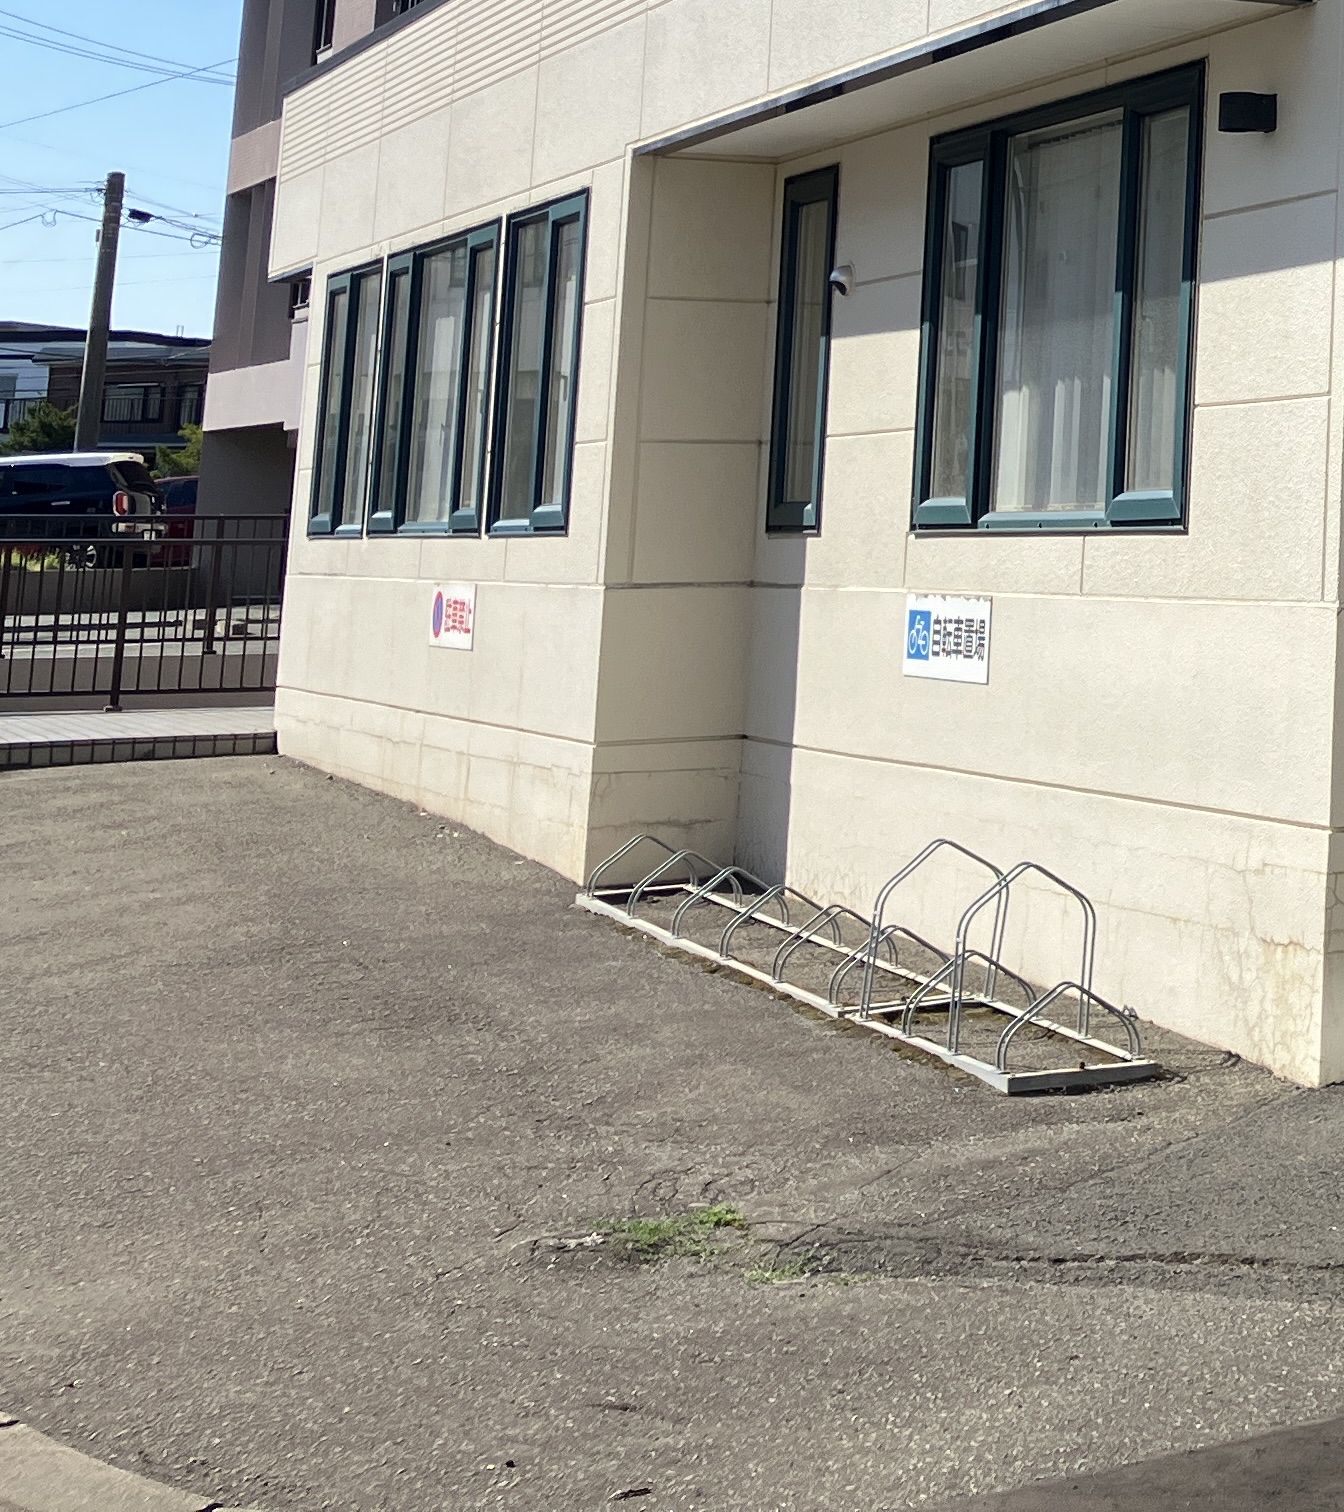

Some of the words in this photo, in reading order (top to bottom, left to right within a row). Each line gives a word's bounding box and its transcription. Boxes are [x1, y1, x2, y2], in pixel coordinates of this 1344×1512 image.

[932, 614, 986, 661] 自転車置場
